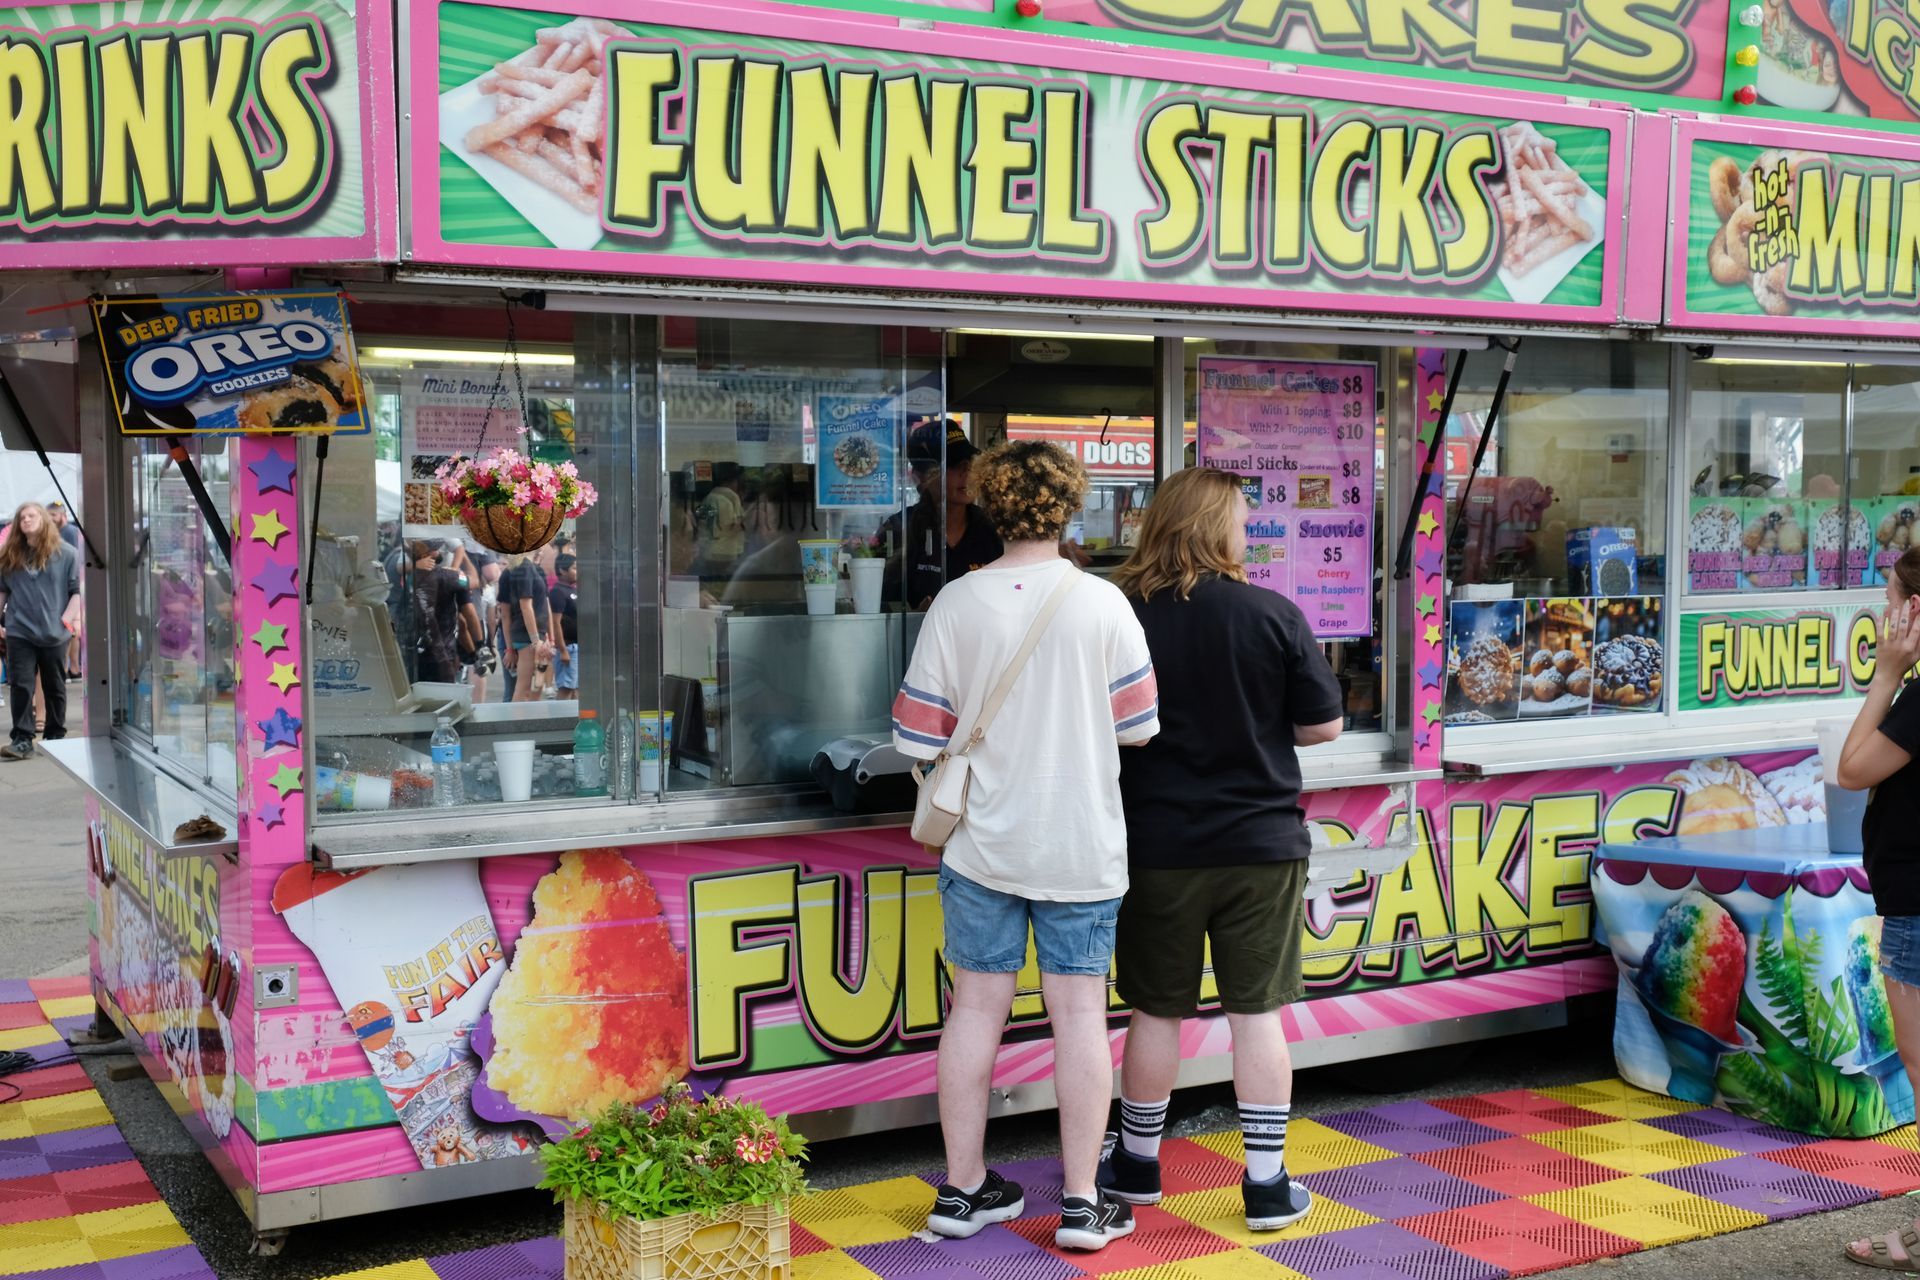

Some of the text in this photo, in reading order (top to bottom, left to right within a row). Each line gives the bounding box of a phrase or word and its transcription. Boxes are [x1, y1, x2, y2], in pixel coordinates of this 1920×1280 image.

[1095, 0, 1692, 82] KES
[609, 47, 1502, 277] FUNNEL STICKS
[1753, 158, 1790, 212] hot
[118, 300, 261, 347] DEEP FRIED
[131, 322, 328, 393] OREO
[210, 366, 290, 394] COOKIES
[421, 378, 457, 394] Mini
[1202, 367, 1277, 391] Funnel
[1342, 375, 1364, 395] $8
[832, 402, 882, 420] OREO
[1260, 404, 1283, 416] With
[1293, 405, 1332, 419] Topping:
[1343, 400, 1363, 419] $9
[827, 417, 888, 435] Funnel Cake
[1249, 423, 1272, 433] With
[1287, 423, 1330, 438] Toppings:
[1337, 422, 1364, 441] $10
[1083, 440, 1152, 466] DOGS
[1202, 454, 1253, 471] Funnel
[1256, 454, 1299, 471] Sticks
[1342, 459, 1361, 478] $8
[1267, 484, 1287, 504] $8
[1342, 486, 1361, 505] $8
[1243, 519, 1287, 538] rinks
[1299, 519, 1366, 539] Snowie
[1323, 546, 1343, 563] $5
[1688, 550, 1742, 572] FUNNEL
[1259, 568, 1271, 580] $4
[1317, 569, 1351, 580] Cherry
[1296, 585, 1366, 597] Blue Raspberry
[1320, 602, 1345, 612] Lime
[1318, 618, 1348, 630] Grape
[1700, 615, 1842, 695] FUNNEL
[381, 914, 492, 990] FUN AT THE
[391, 932, 505, 1024] FAIR
